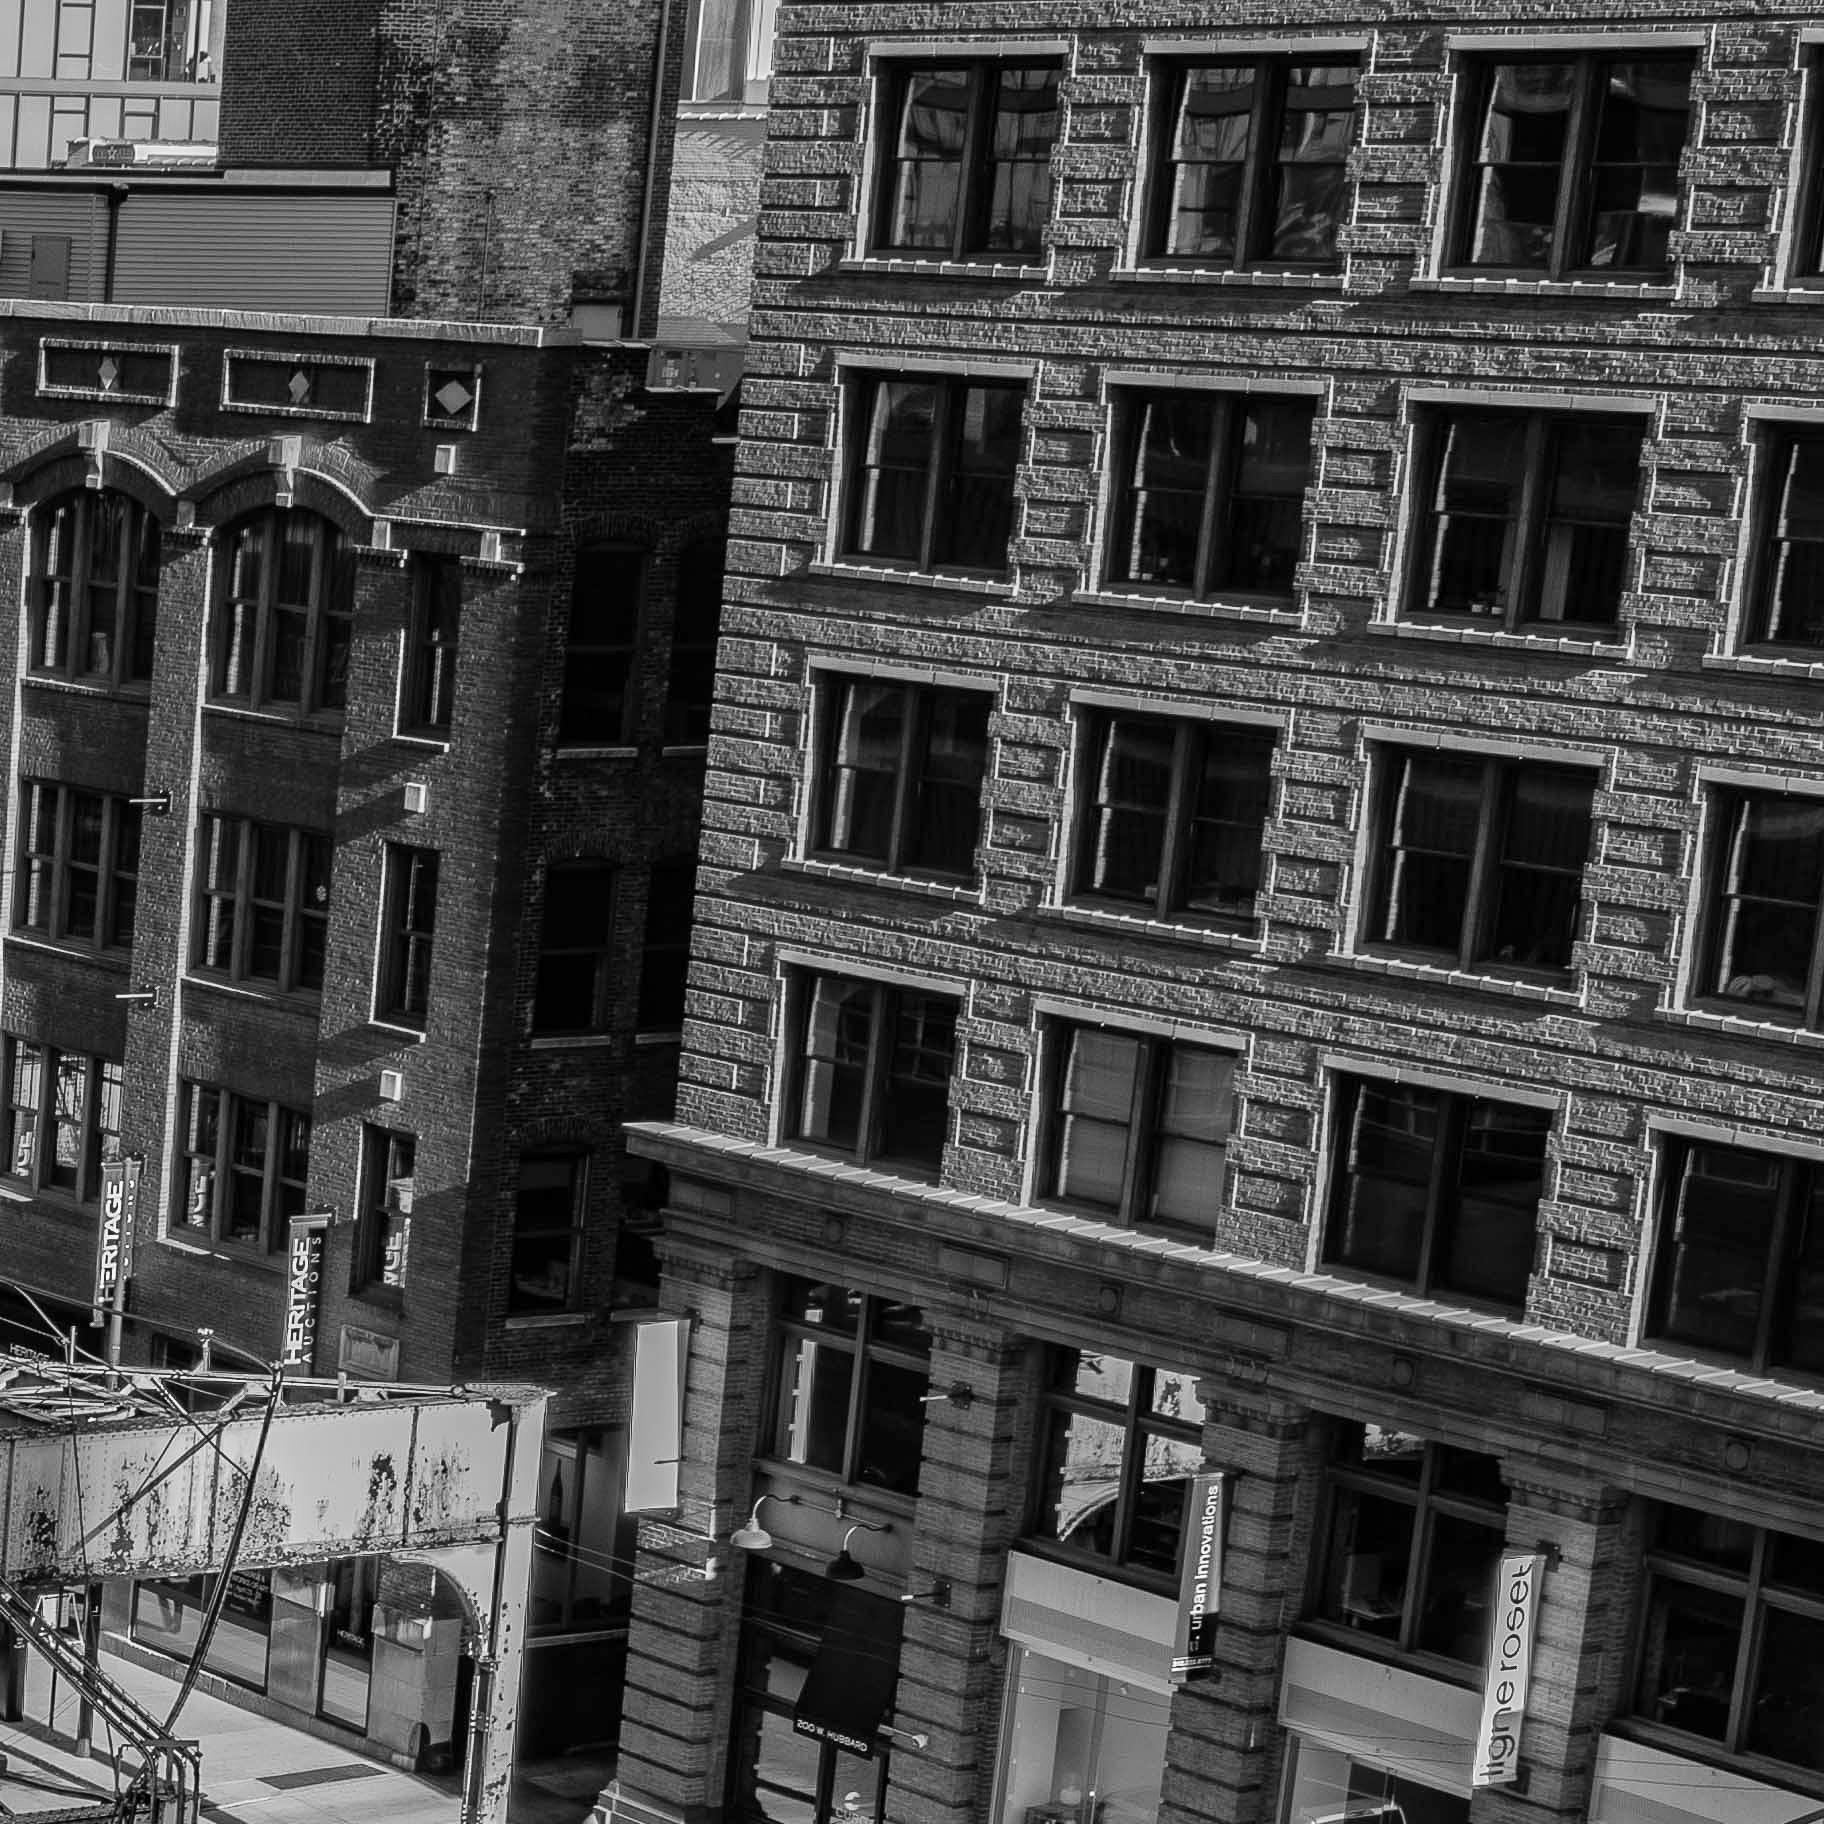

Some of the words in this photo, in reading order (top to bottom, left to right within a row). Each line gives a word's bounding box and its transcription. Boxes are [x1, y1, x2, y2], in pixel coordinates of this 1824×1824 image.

[96, 1180, 124, 1303] HERITAGE
[284, 1236, 312, 1366] HERITAGE
[302, 1235, 323, 1364] AUCTIONS
[1194, 1484, 1220, 1581] innovations
[1190, 1581, 1207, 1631] urban
[1479, 1680, 1515, 1777] ligne
[1500, 1562, 1533, 1673] roset
[796, 1719, 816, 1733] 200
[826, 1730, 868, 1752] HUBBARD
